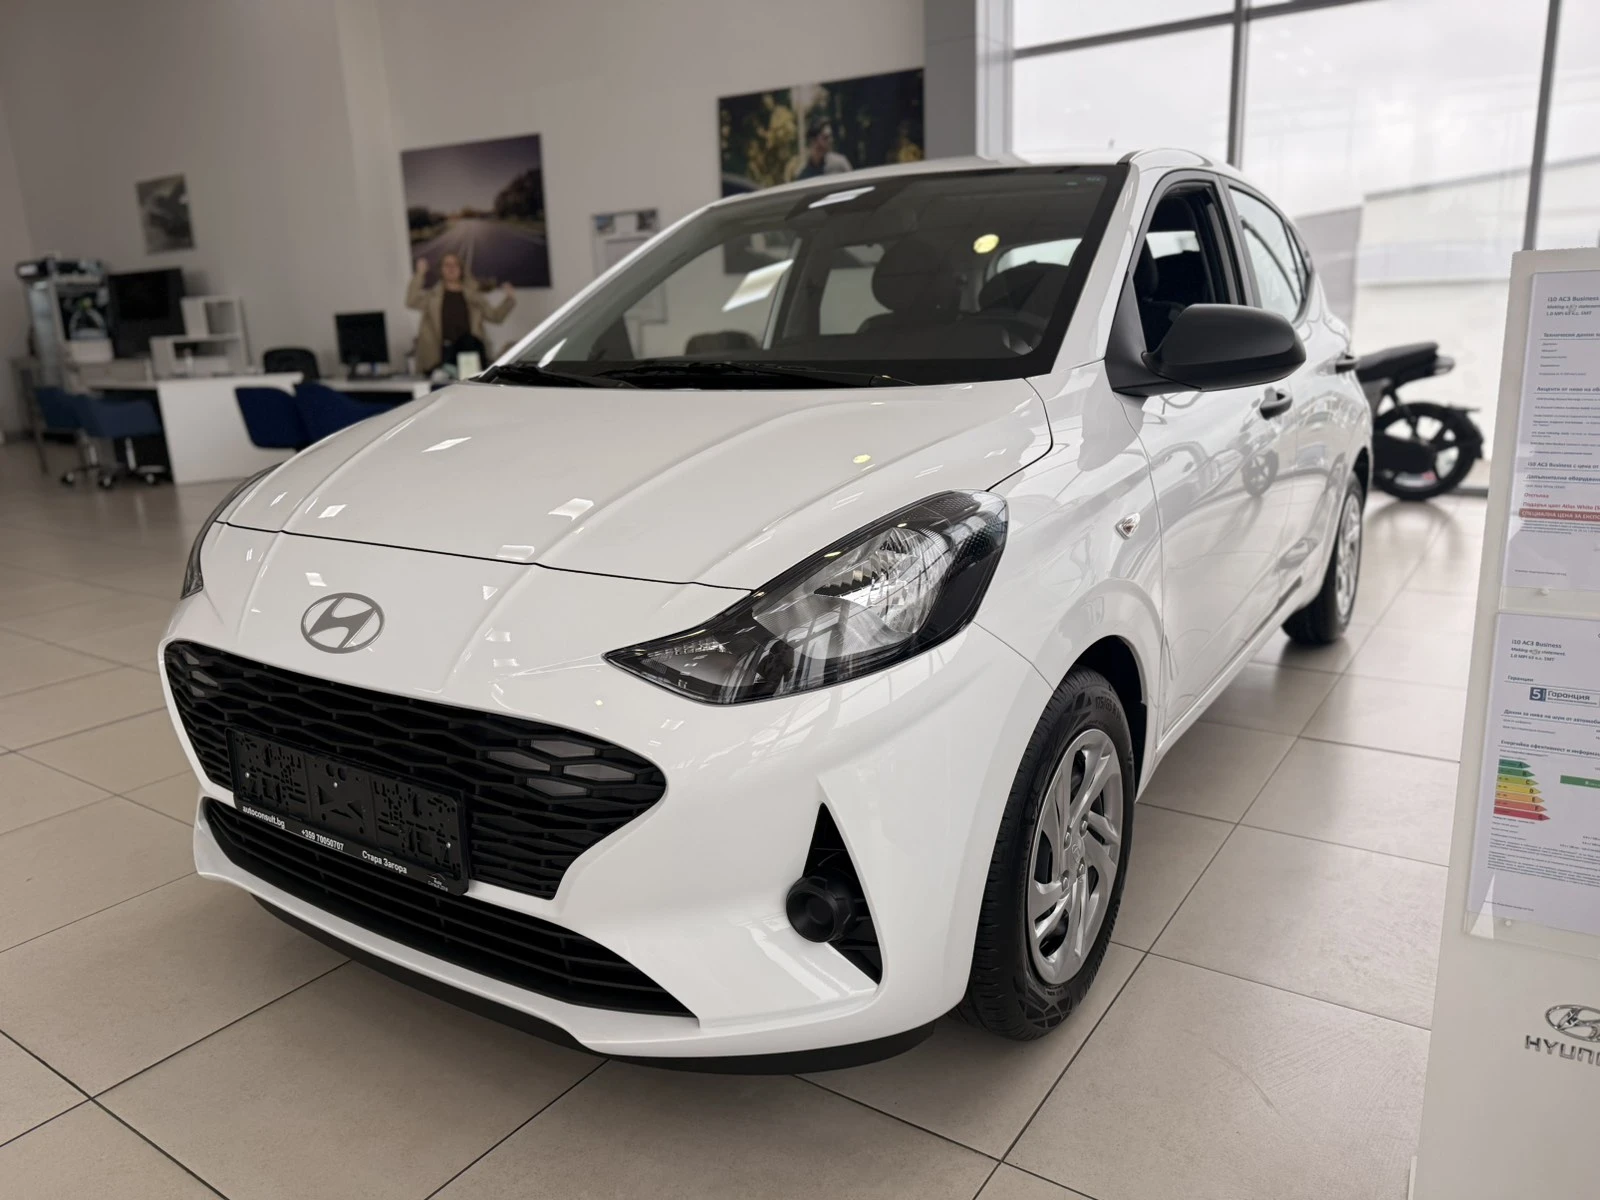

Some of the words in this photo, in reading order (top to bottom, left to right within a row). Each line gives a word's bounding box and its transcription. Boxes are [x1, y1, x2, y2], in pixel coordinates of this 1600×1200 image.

[1521, 510, 1556, 518] СПЕЦИАЛНА
[1535, 641, 1562, 649] Business
[1531, 689, 1541, 700] 5
[1547, 690, 1591, 701] Гаранция
[242, 806, 285, 829] autoconsult.bg
[301, 829, 316, 840] +359
[316, 833, 344, 851] 70050707
[362, 850, 383, 865] Стара
[383, 858, 408, 874] Загора
